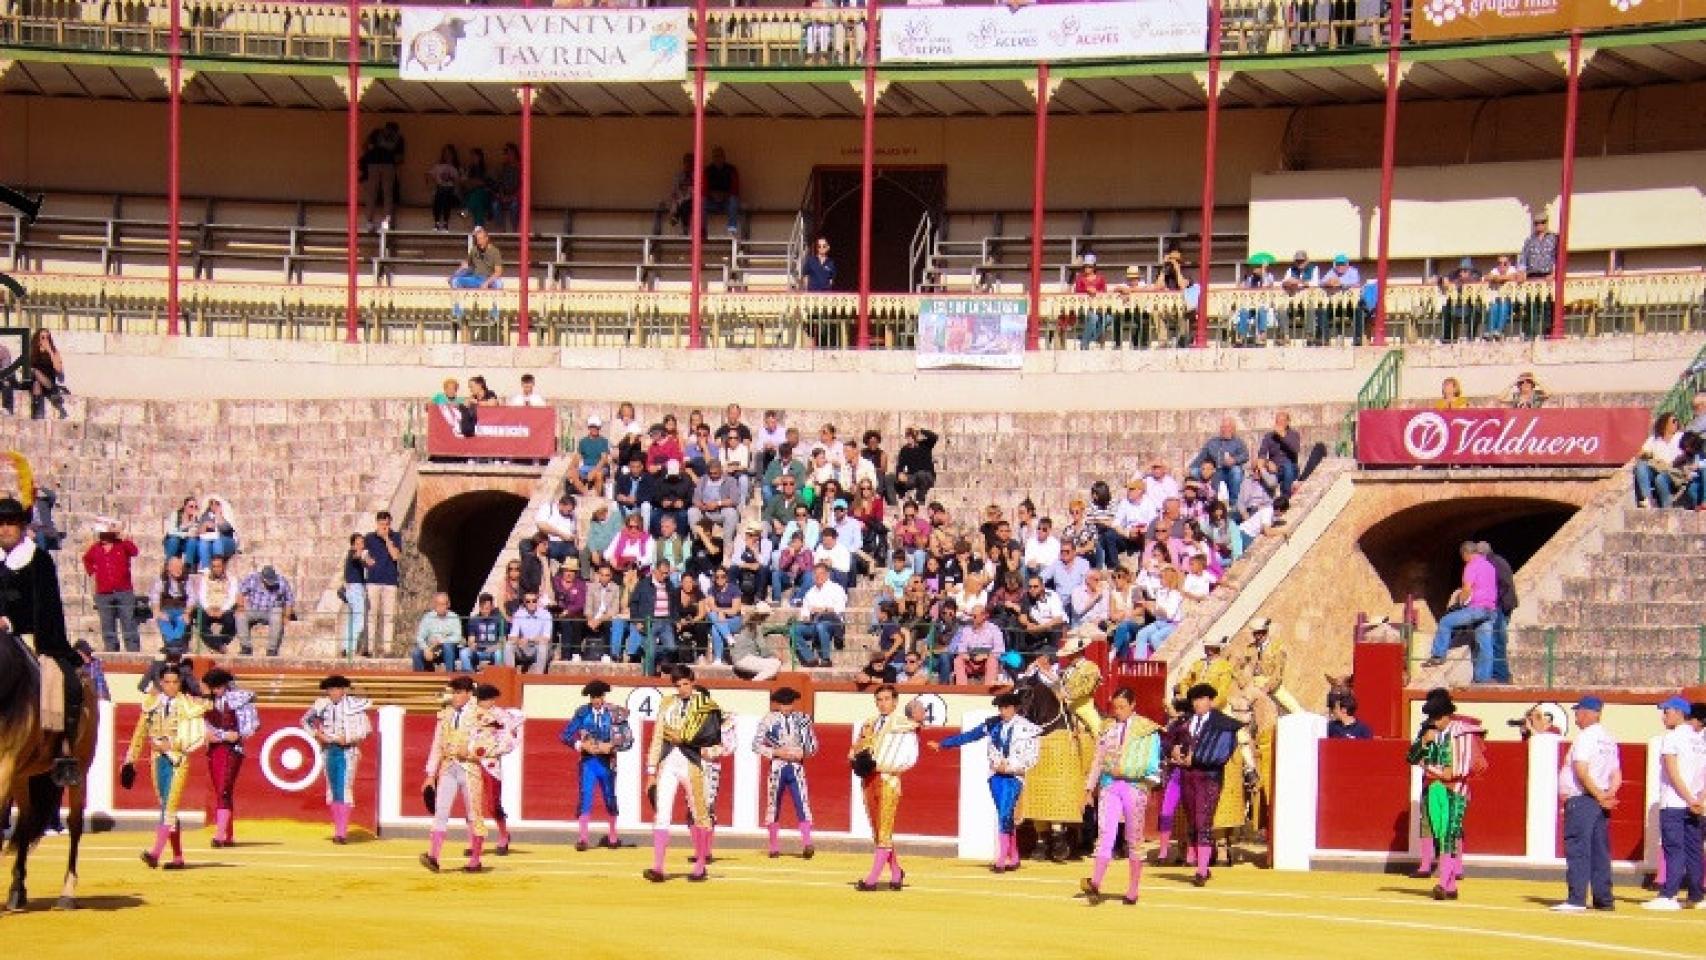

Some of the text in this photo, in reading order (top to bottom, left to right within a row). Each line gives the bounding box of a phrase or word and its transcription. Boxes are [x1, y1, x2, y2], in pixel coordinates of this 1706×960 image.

[494, 45, 627, 65] TAVRINA
[1450, 417, 1600, 456] Valduero
[639, 696, 652, 716] 4
